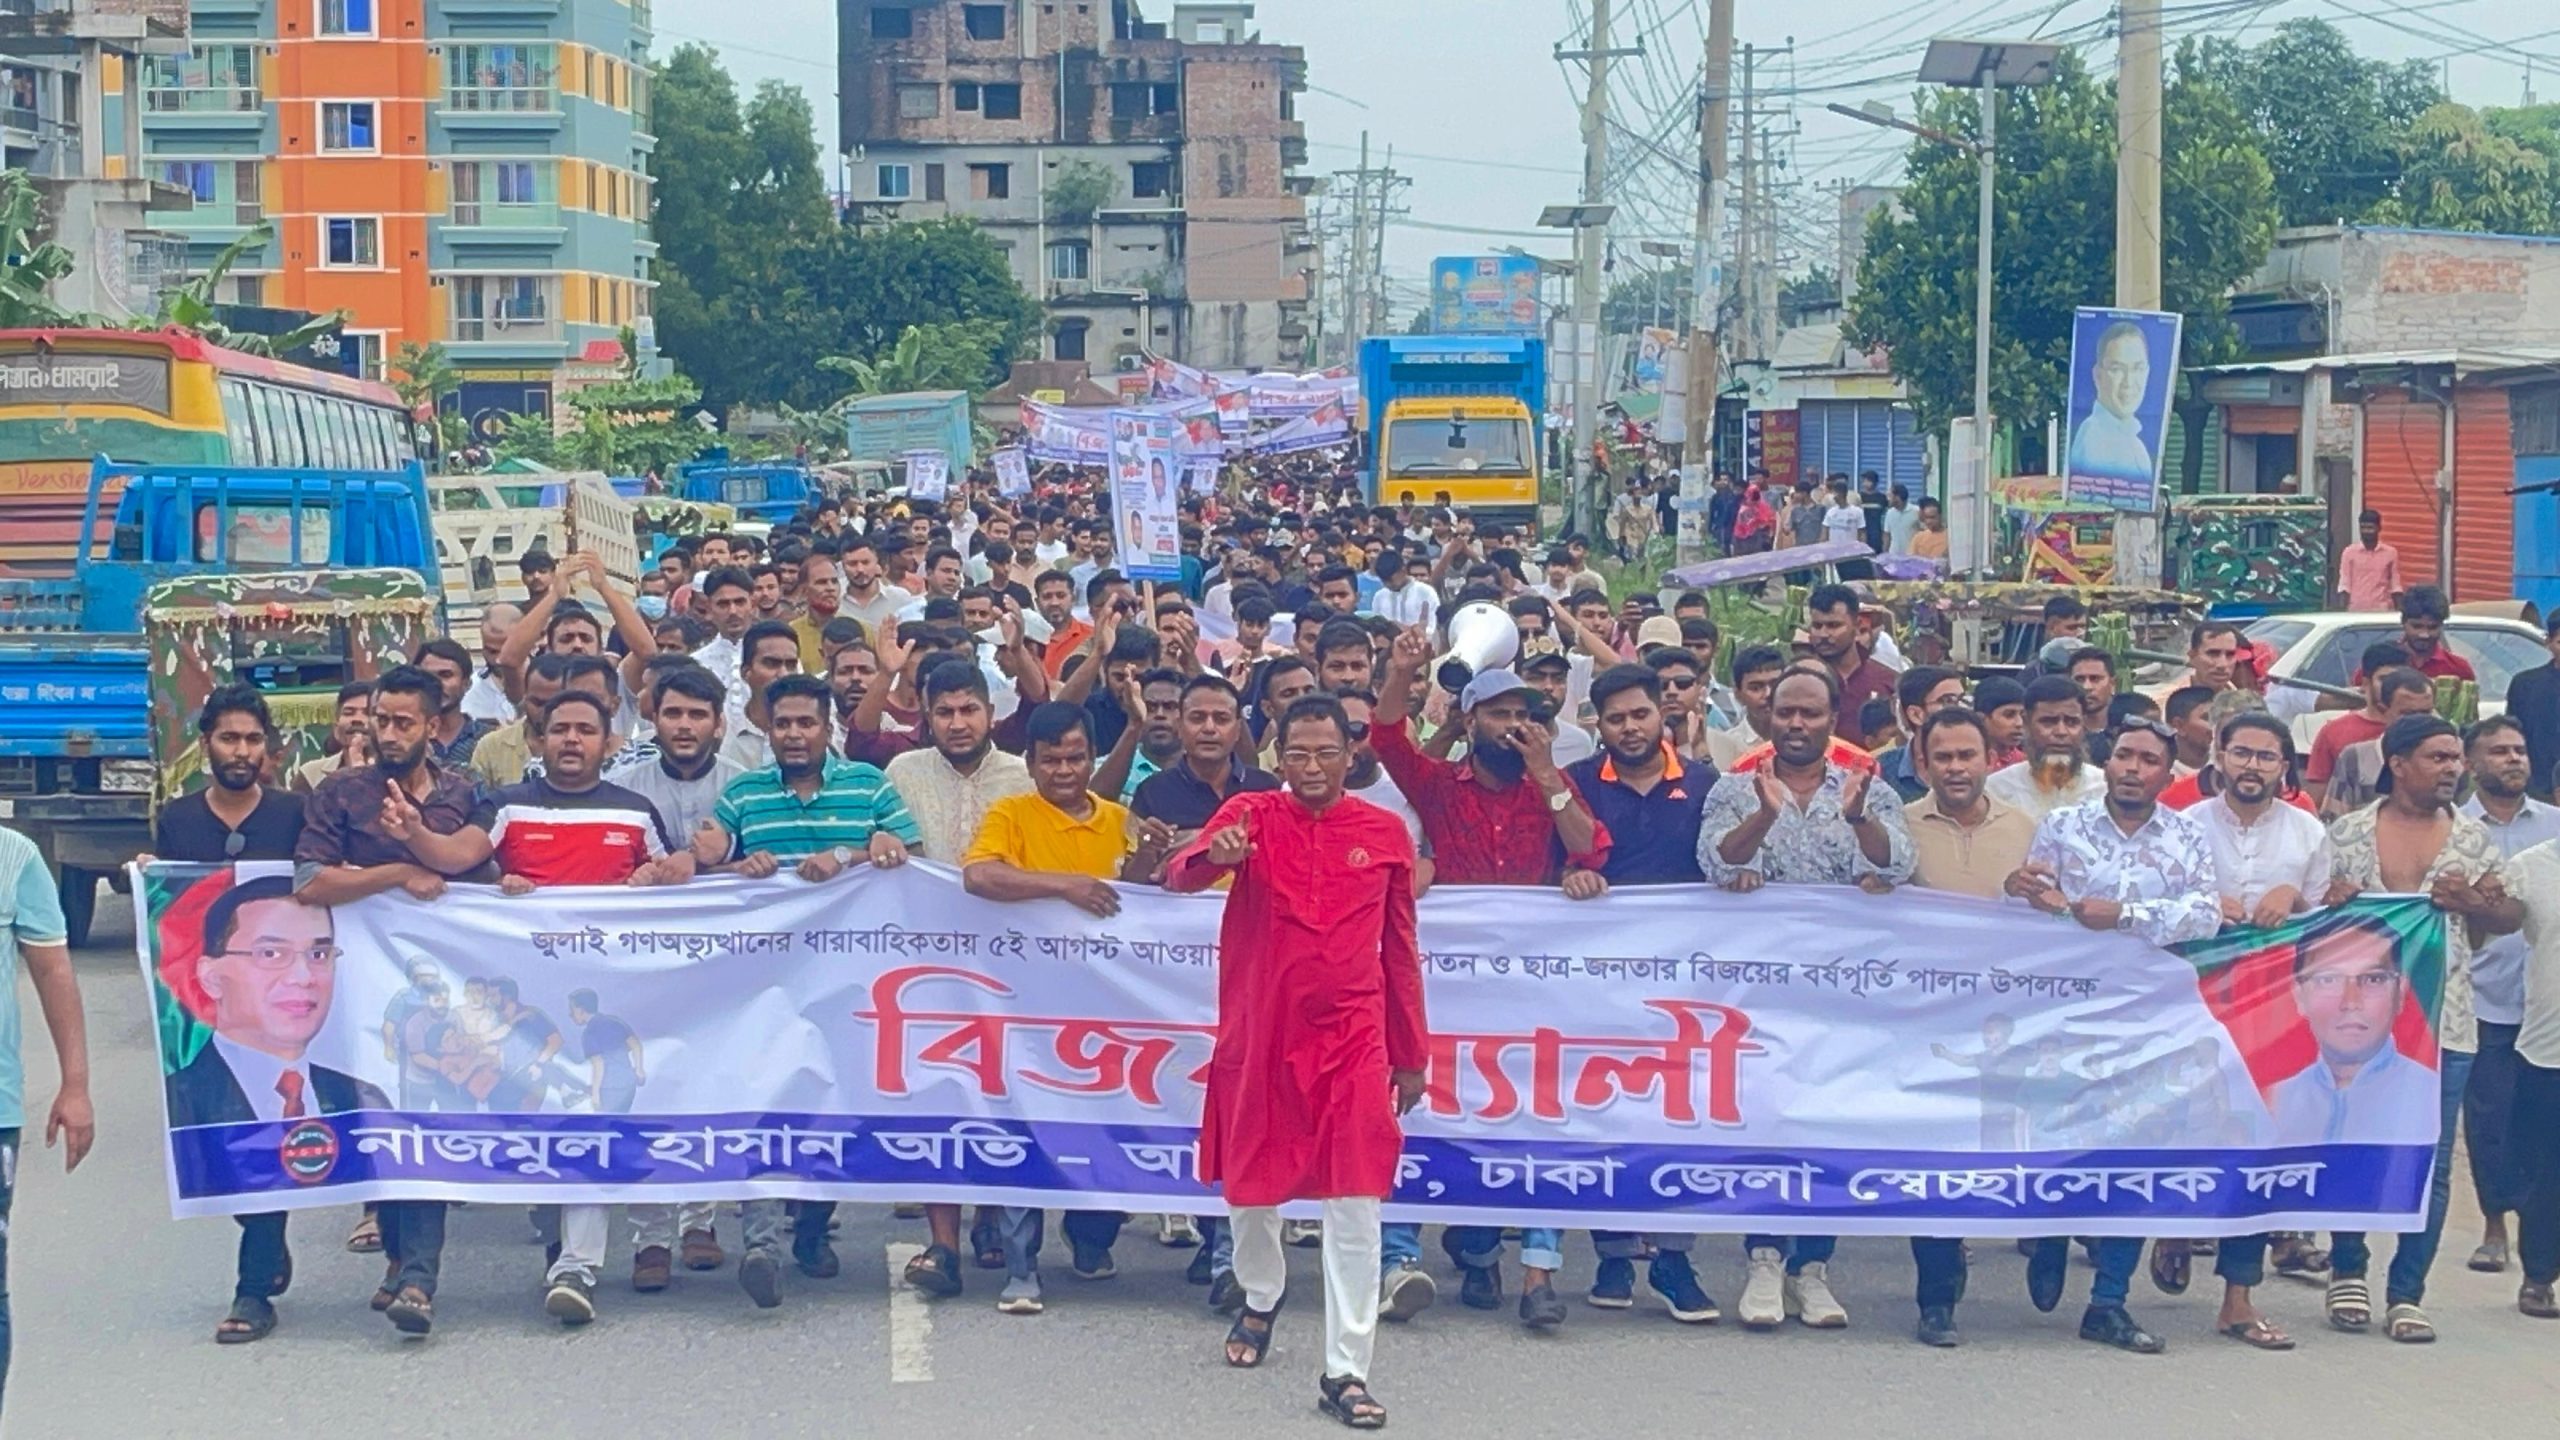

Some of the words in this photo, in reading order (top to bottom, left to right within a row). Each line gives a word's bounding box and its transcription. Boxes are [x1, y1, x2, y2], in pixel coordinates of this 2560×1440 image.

[530, 926, 608, 960] জুলাই
[618, 930, 794, 961] গণঅভ্যুত্থানের
[803, 922, 980, 957] ধারাবাহিকতায়
[988, 928, 1028, 961] ৫ই
[1036, 933, 1124, 961] আগস্ট
[1130, 940, 1221, 967] আওয়া
[1489, 955, 1511, 975] ও
[1520, 954, 1680, 981] ছাত্র-জনতার
[1688, 951, 1793, 985] বিজয়ের
[1799, 957, 1900, 998] বর্ষপূর্তি
[1906, 968, 1982, 995] পালন
[1988, 966, 2101, 999] উপলক্ষে
[856, 966, 1211, 1104] বিজ
[349, 1124, 622, 1179] নাজমুল
[640, 1124, 857, 1171] হাসান
[872, 1120, 1032, 1170] অভি
[1471, 1153, 1626, 1196] ঢাকা
[1650, 1161, 1823, 1203] জেলা
[1848, 1164, 2224, 1208] স্বেচ্ছাসেবক
[2238, 1161, 2328, 1201] দল
